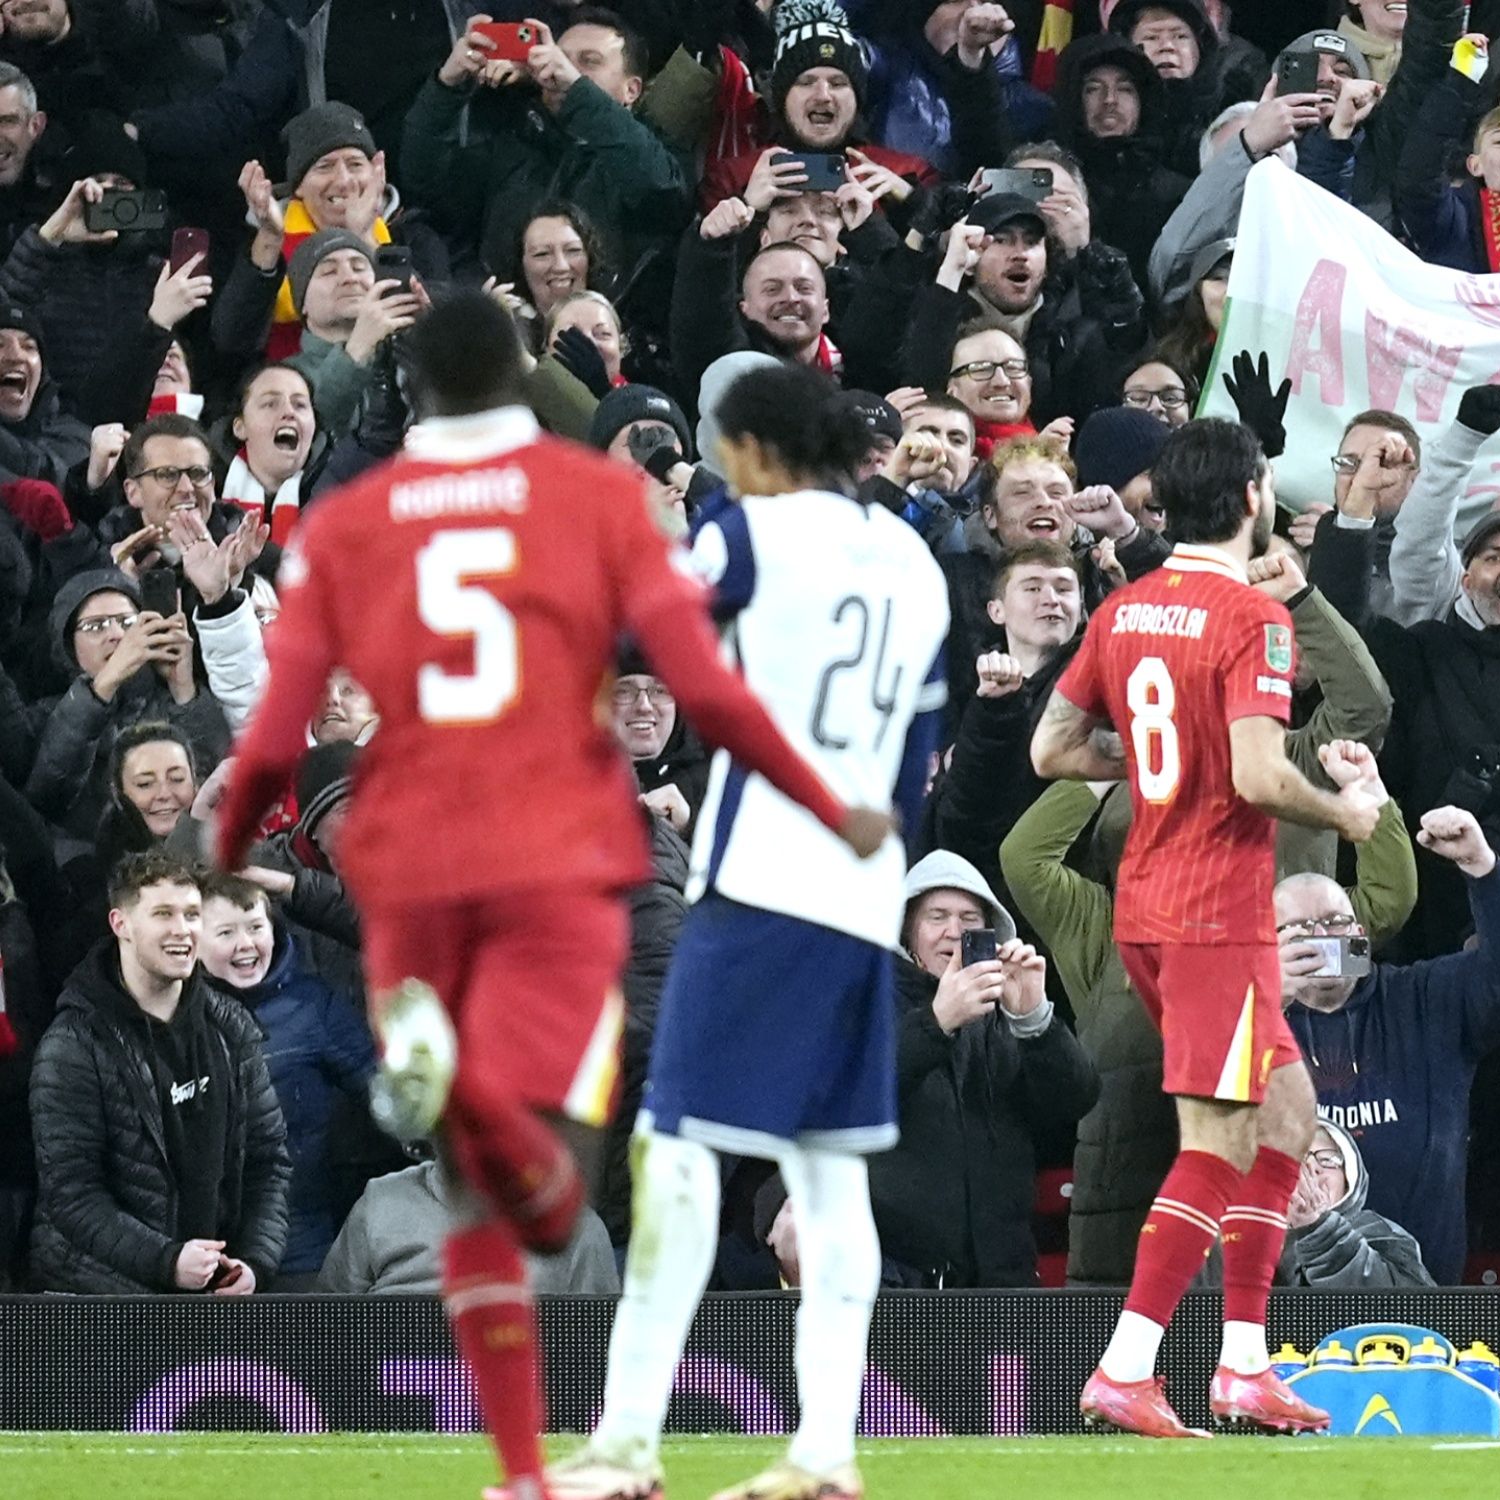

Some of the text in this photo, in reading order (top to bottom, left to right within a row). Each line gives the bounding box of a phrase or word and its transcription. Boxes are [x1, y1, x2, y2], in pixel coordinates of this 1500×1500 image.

[415, 528, 524, 727] 5
[812, 595, 903, 754] 24
[1112, 603, 1209, 640] SZOBOSZLAI
[1127, 656, 1182, 805] 8
